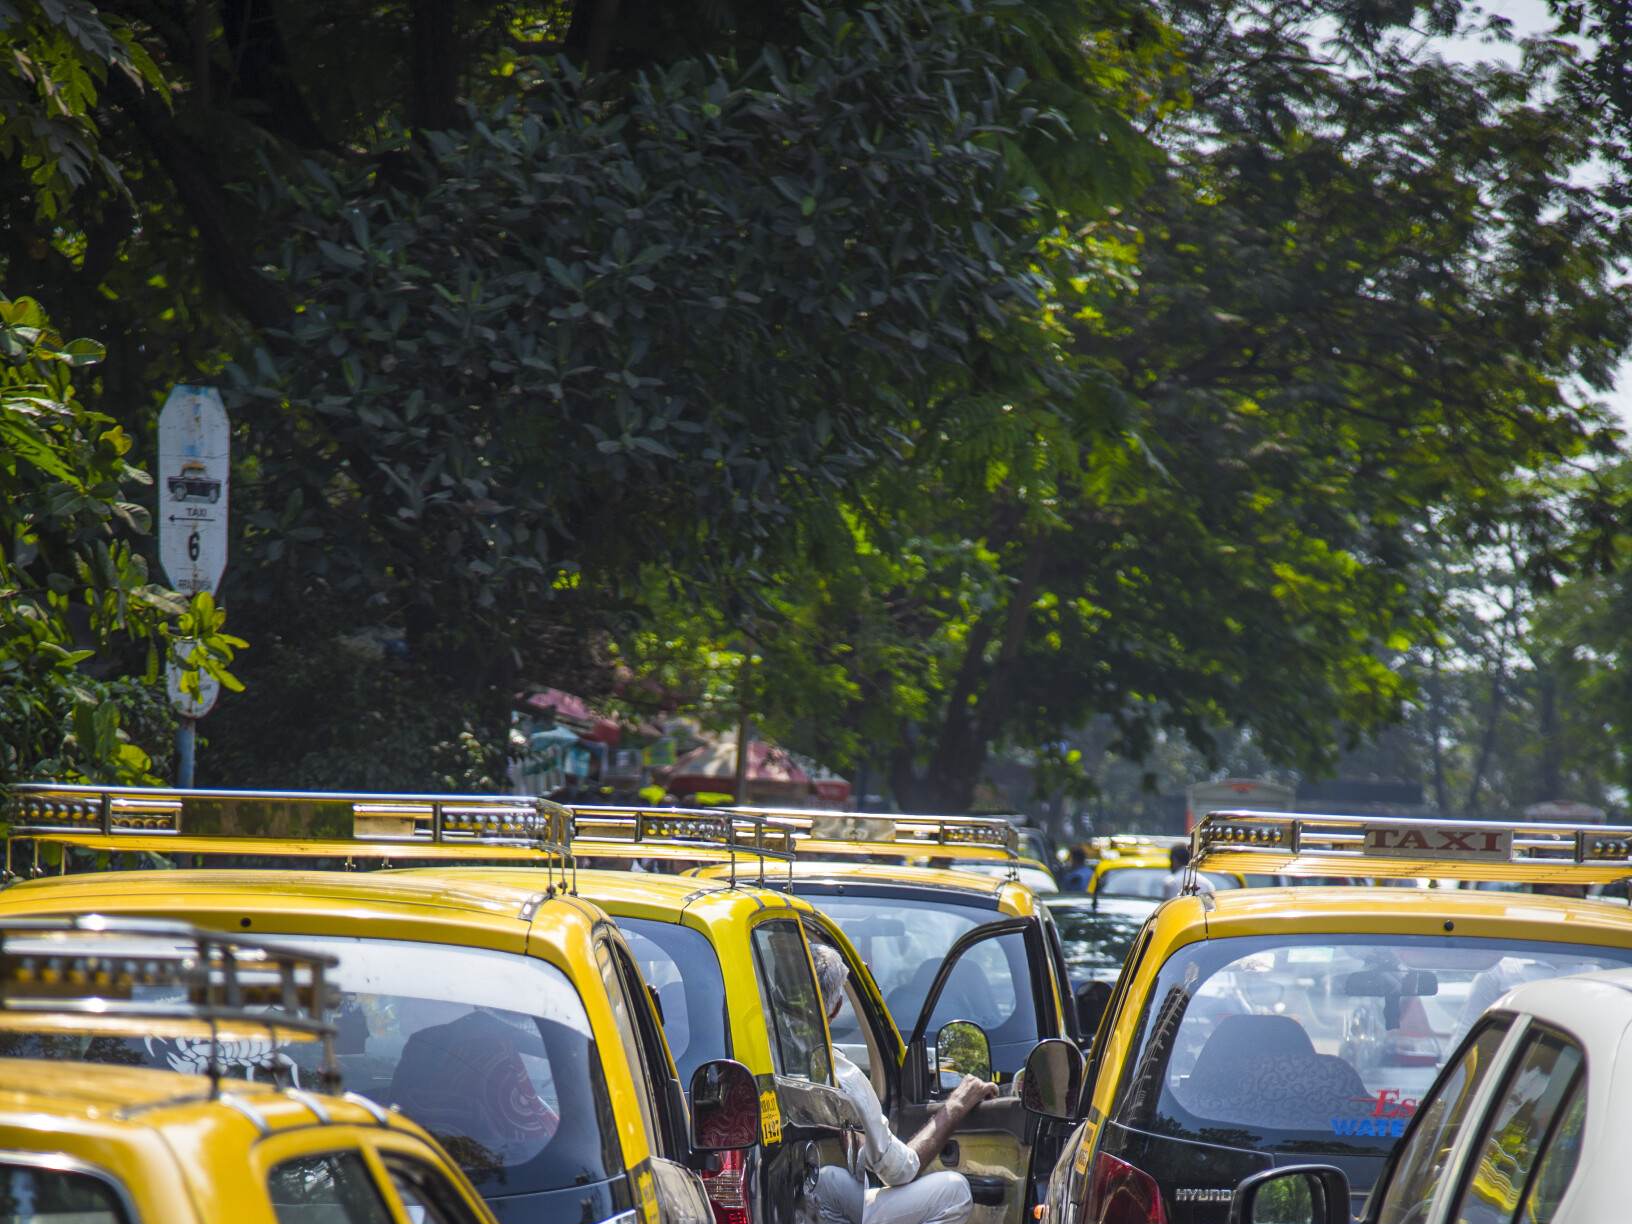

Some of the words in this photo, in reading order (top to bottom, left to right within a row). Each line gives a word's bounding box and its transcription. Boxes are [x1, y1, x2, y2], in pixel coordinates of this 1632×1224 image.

[185, 507, 208, 517] TAXI
[188, 531, 200, 561] 6
[1364, 829, 1503, 852] TAXI
[1367, 1089, 1422, 1118] Es
[1331, 1118, 1410, 1138] WATE
